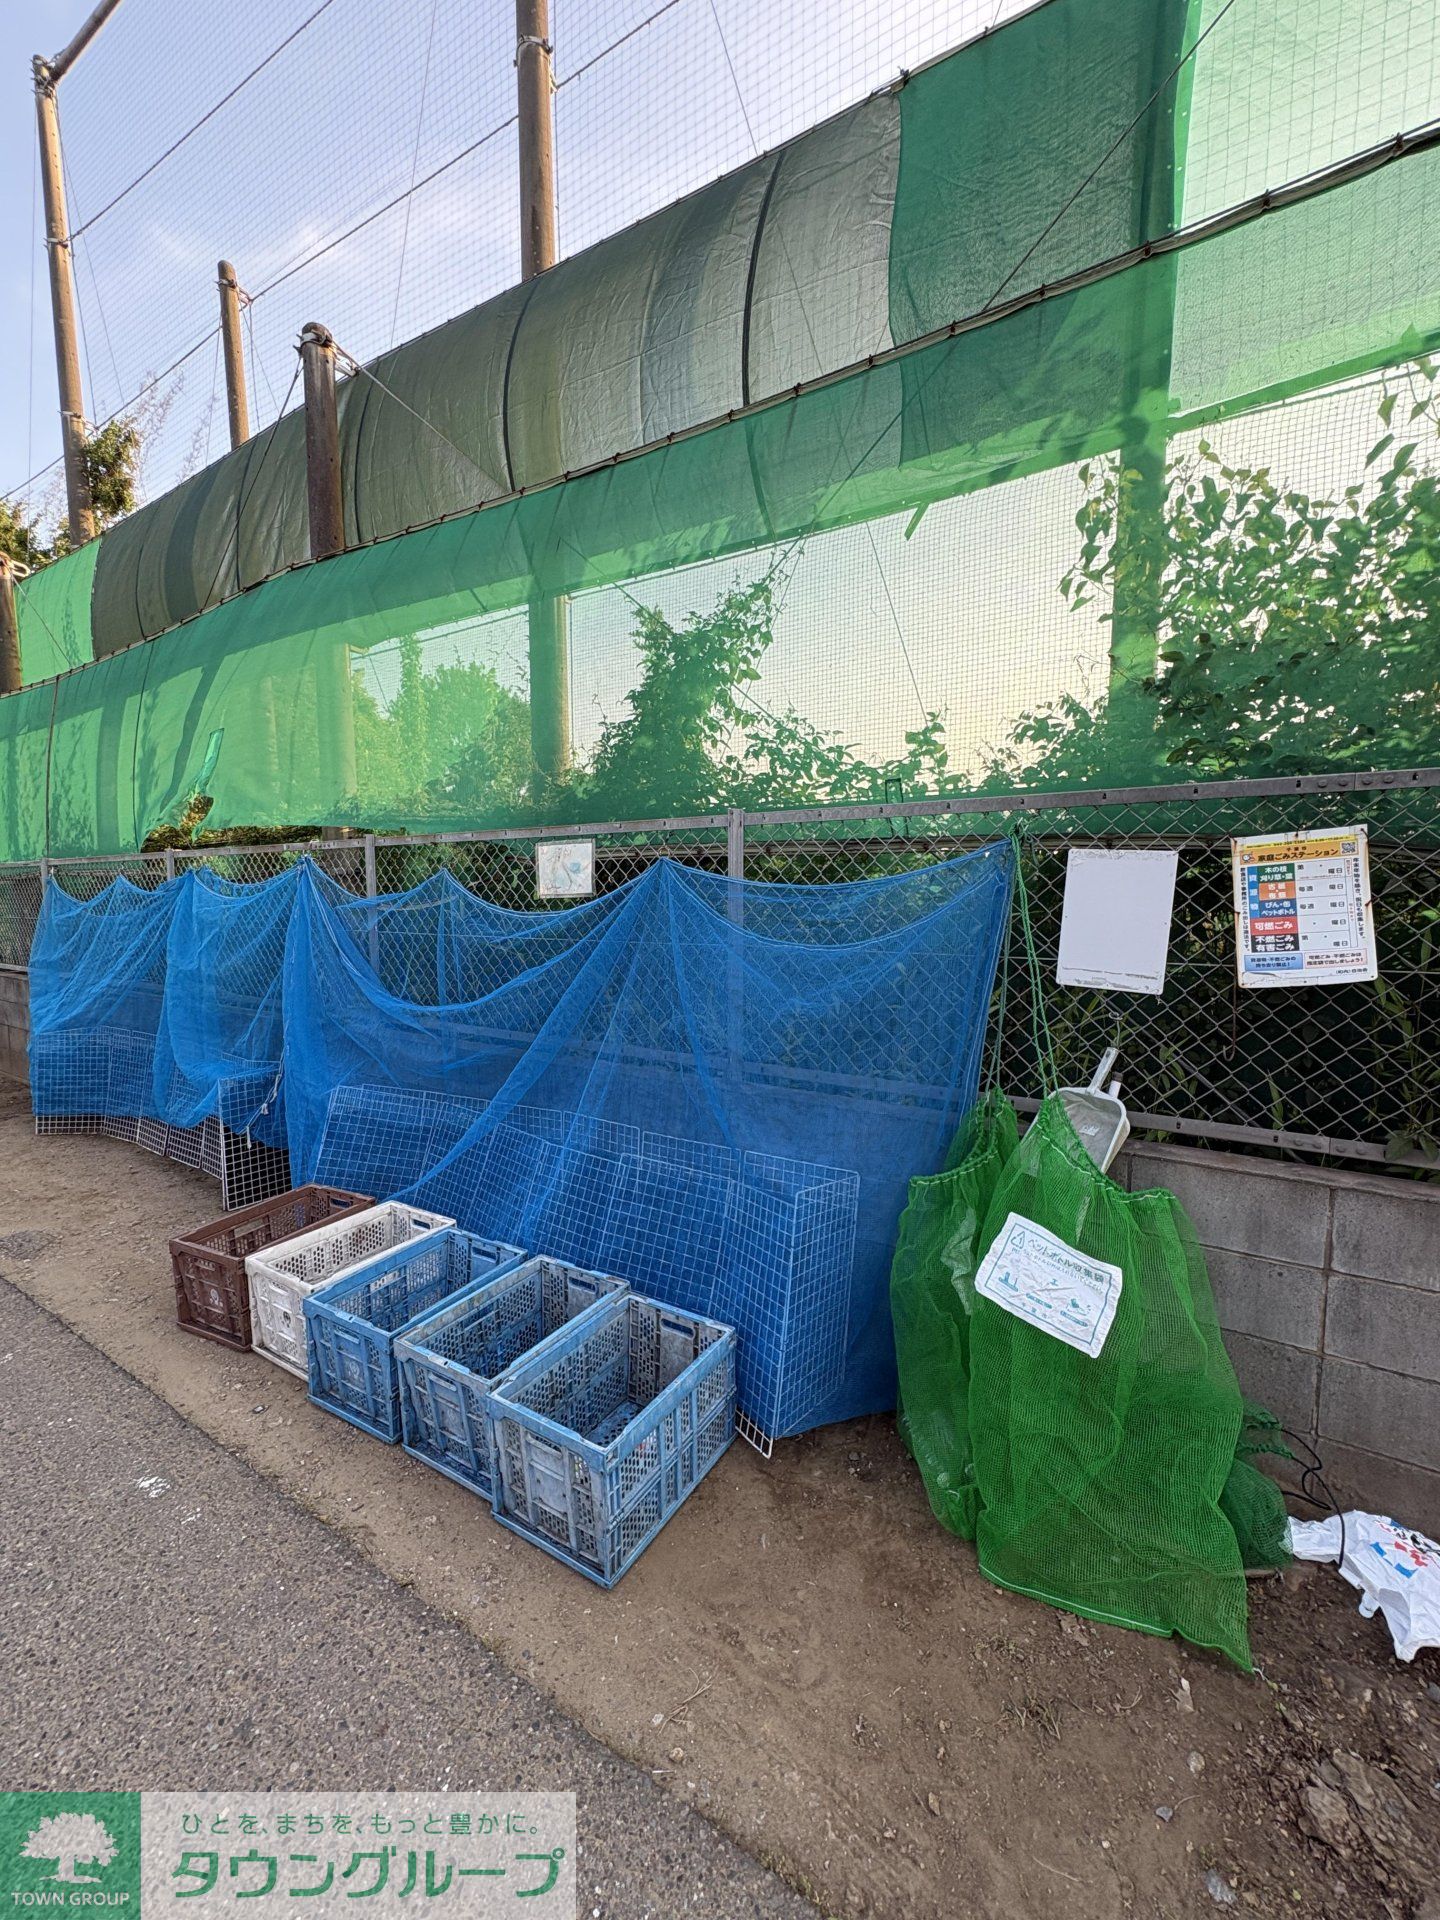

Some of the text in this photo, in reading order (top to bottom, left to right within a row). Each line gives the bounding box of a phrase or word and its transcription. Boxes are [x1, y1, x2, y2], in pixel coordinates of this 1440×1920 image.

[1258, 849, 1339, 862] 家庭ごみステーション
[1254, 921, 1294, 931] 可燃ごみ
[1255, 934, 1295, 943] 不燃ごみ
[1255, 943, 1295, 952] 有害ごみ
